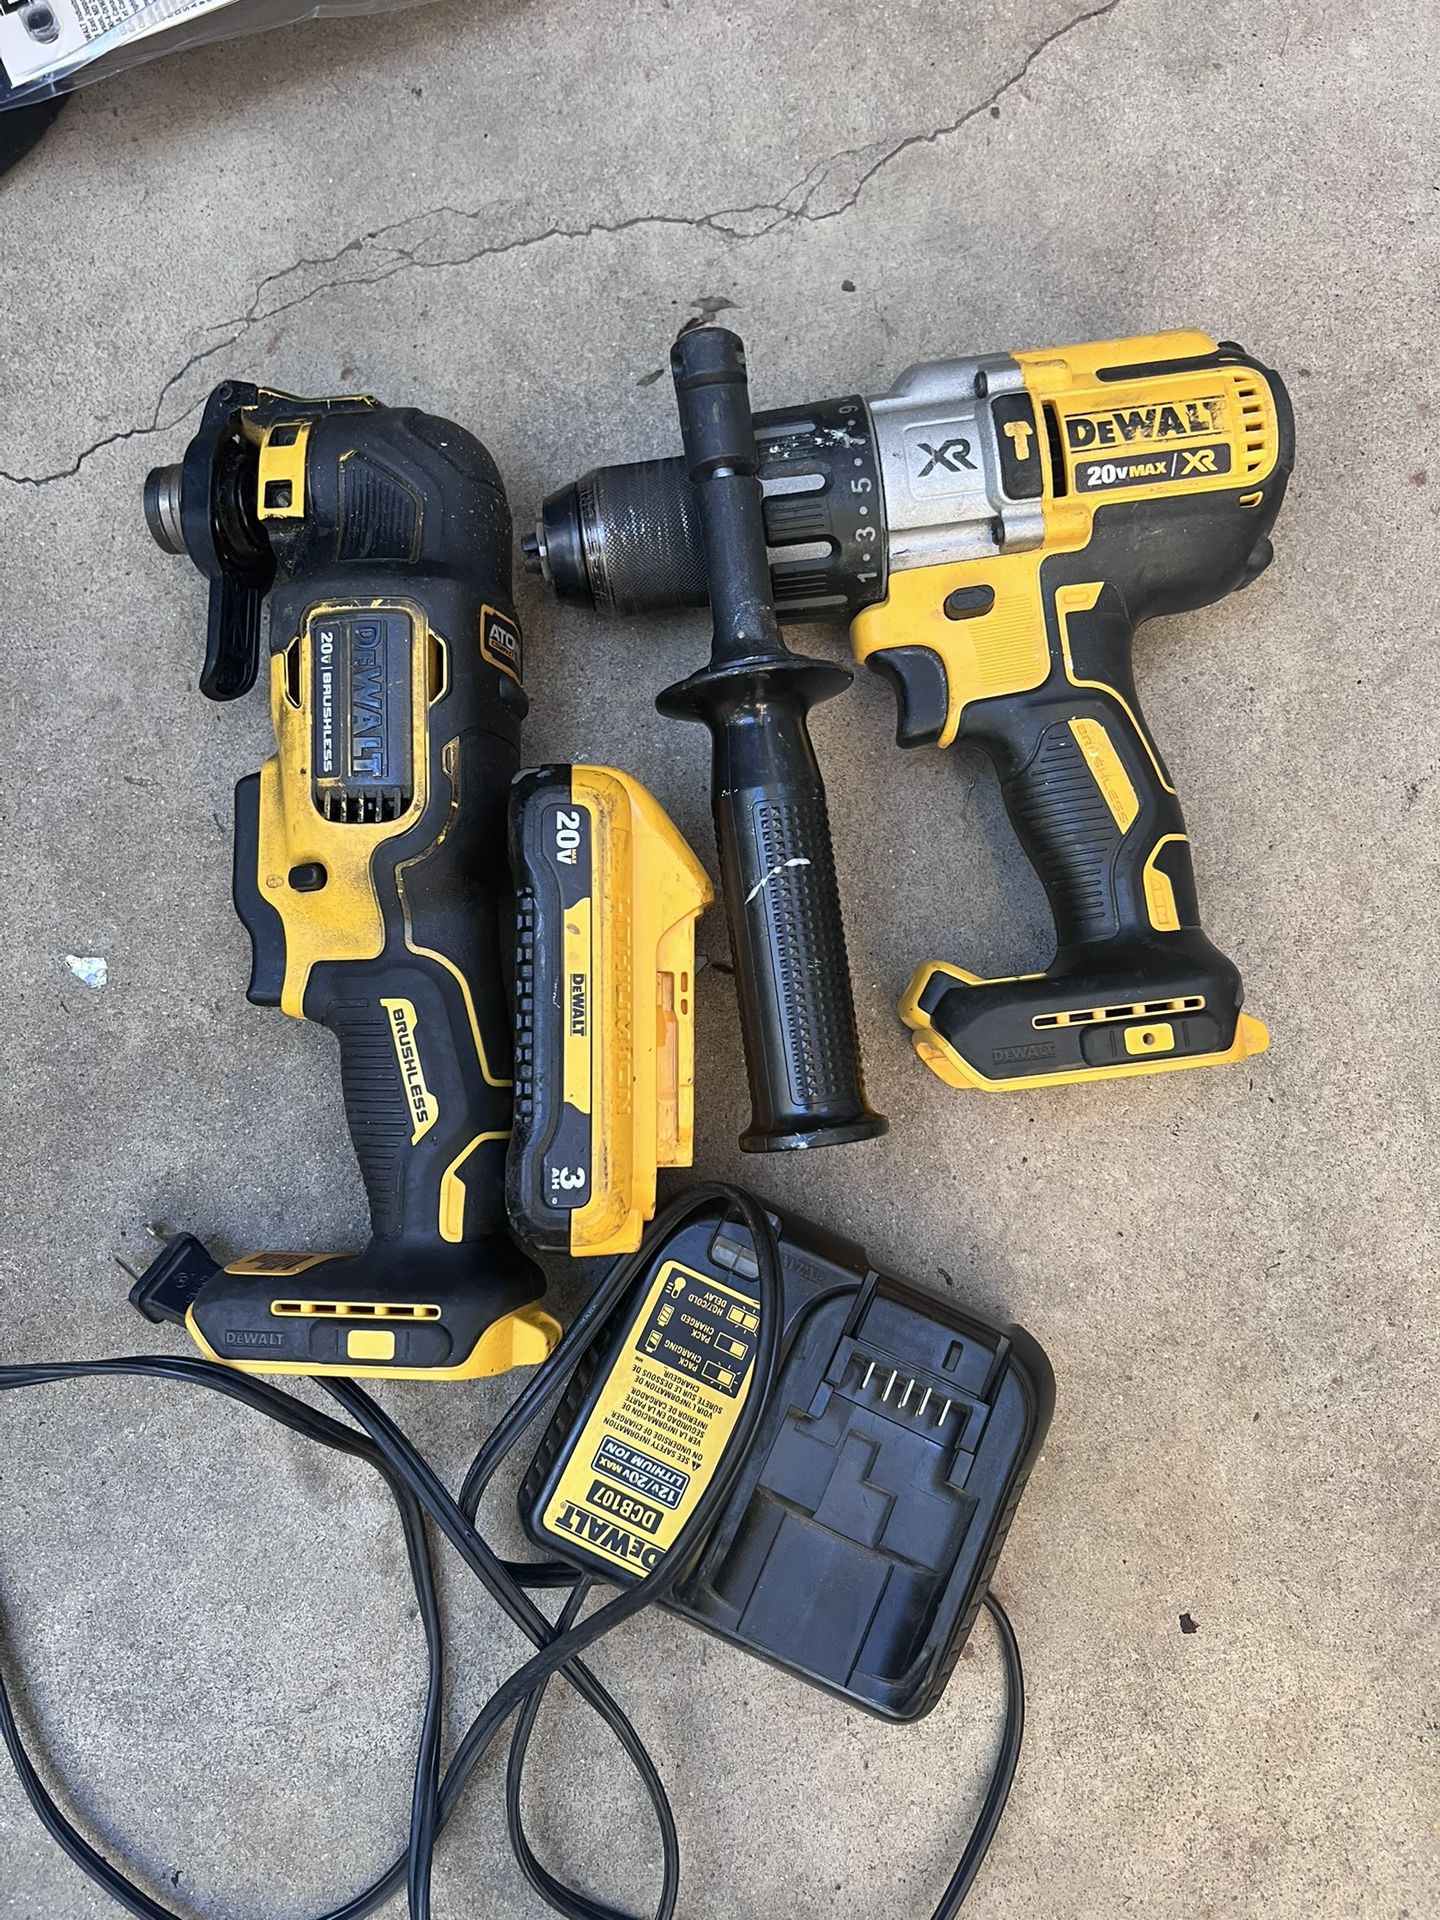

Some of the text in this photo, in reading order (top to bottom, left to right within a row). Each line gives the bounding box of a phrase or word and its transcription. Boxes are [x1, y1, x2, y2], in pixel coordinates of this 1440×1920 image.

[1066, 400, 1227, 448] DEWALT
[916, 439, 978, 477] XR
[851, 477, 872, 493] 5
[855, 526, 876, 542] 3
[351, 620, 383, 777] DEWALT
[322, 671, 334, 773] BRUSHLESS
[556, 810, 581, 865] 20V
[572, 973, 585, 1037] DEWALT
[392, 1008, 428, 1122] BRUSHLESS
[551, 1167, 560, 1190] AH
[559, 1166, 586, 1190] 3
[687, 1293, 724, 1317] HOT/COLD
[703, 1291, 728, 1308] DELAY
[680, 1313, 715, 1336] CHARGED
[690, 1328, 712, 1344] PACK
[226, 1332, 285, 1345] DEWALT
[663, 1339, 702, 1364] CHARGING
[631, 1363, 642, 1374] DE
[678, 1356, 699, 1372] PACK
[641, 1369, 674, 1390] DESSOUS
[673, 1384, 683, 1395] LE
[621, 1401, 632, 1412] DE
[634, 1375, 713, 1420] VOIR L'INFORMATION DE
[682, 1389, 698, 1402] SUR
[625, 1393, 706, 1439] SEGURIDAD EN LA PARTE
[667, 1404, 678, 1416] DE
[677, 1410, 709, 1431] INFERIOR
[602, 1416, 691, 1465] SEE SAFETY INFORMATION
[642, 1427, 653, 1437] OF
[652, 1431, 692, 1456] UNDERSIDE
[678, 1430, 689, 1440] LA
[687, 1435, 701, 1447] VER
[598, 1456, 623, 1474] MAX
[604, 1442, 684, 1487] LITHIUM ION
[691, 1450, 704, 1462] ON
[592, 1486, 657, 1529] DCB107
[555, 1504, 664, 1567] DEWALT
